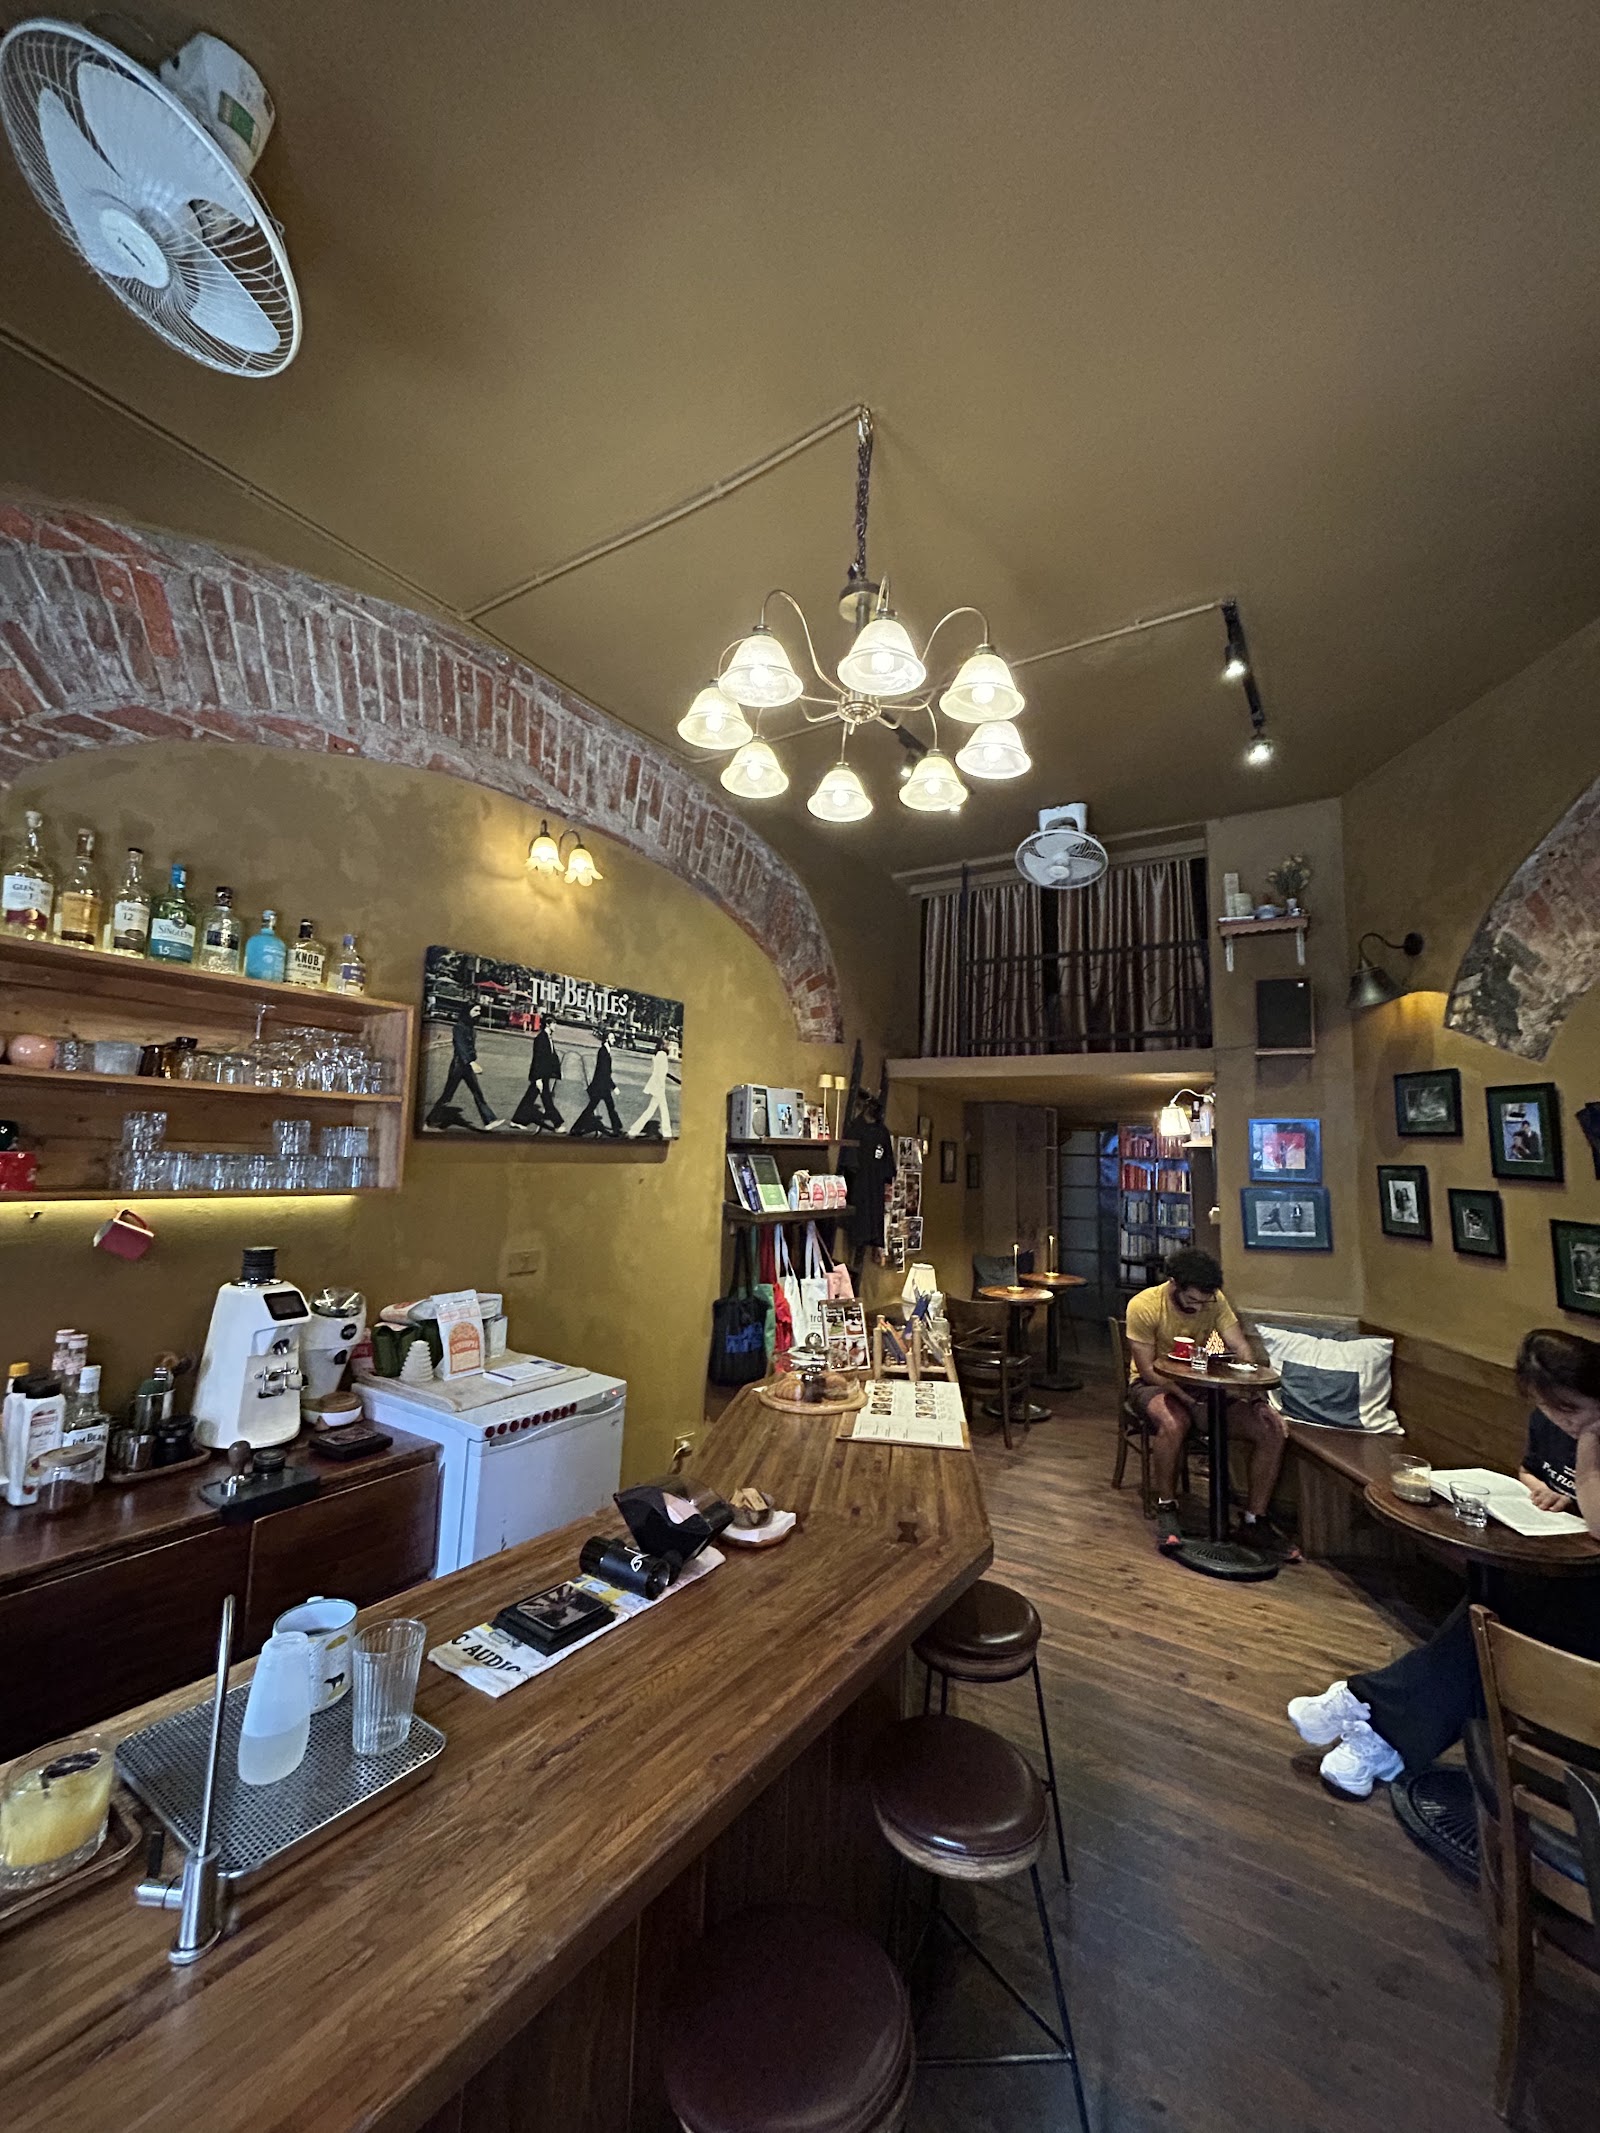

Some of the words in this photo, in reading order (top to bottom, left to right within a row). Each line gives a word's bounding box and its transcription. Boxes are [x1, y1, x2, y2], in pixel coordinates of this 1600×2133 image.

[123, 912, 134, 921] 12
[158, 945, 171, 955] 15
[295, 951, 320, 966] KNOB
[529, 976, 561, 1006] THE
[1556, 1474, 1577, 1490] FLO
[451, 1633, 471, 1646] C
